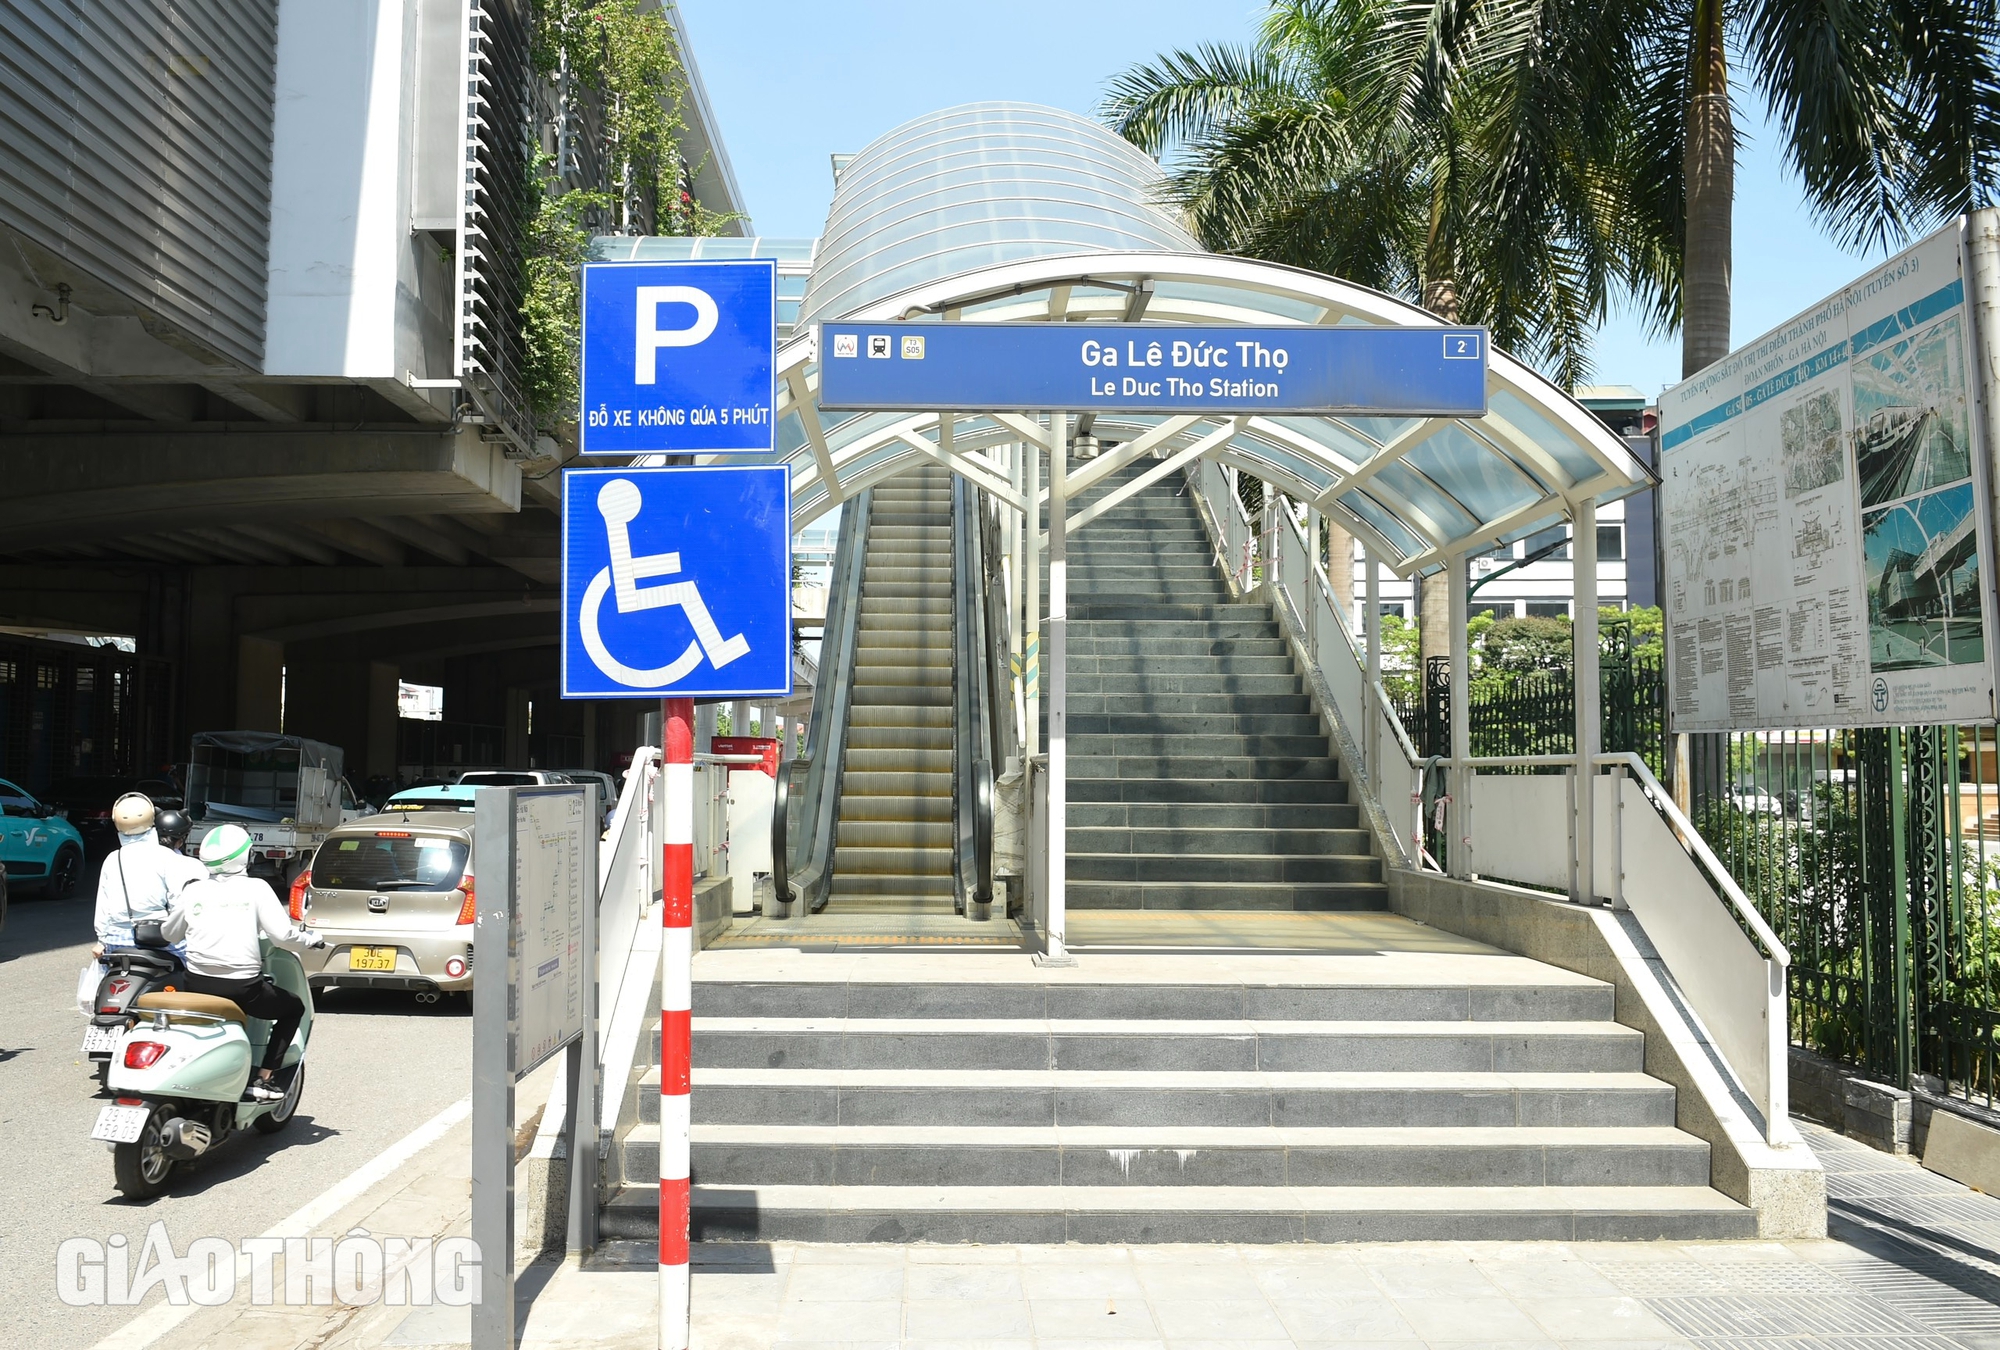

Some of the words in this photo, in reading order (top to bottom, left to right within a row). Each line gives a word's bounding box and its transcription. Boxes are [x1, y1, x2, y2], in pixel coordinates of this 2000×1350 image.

[634, 285, 719, 385] P
[1680, 381, 1699, 402] TUYẾN
[1788, 319, 1815, 341] THÀNH
[1815, 304, 1832, 327] PHỐ
[1846, 291, 1862, 309] NỘI
[1863, 270, 1895, 300] (TUYẾN
[1896, 256, 1909, 281] SỐ
[1910, 256, 1920, 273] 3)
[906, 346, 920, 354] S05
[1457, 340, 1466, 353] 2
[1788, 347, 1800, 361] GA
[1800, 337, 1812, 354] HÀ
[1812, 330, 1828, 348] NỘI
[1081, 340, 1118, 367] Ga
[1128, 340, 1163, 367] Lê
[1171, 340, 1229, 368] Đức
[1235, 341, 1289, 374] Thọ
[1814, 356, 1828, 373] KM
[1091, 377, 1116, 396] Le
[1122, 377, 1161, 396] Duc
[1166, 377, 1203, 397] Tho
[1209, 378, 1279, 397] Station
[588, 403, 608, 427] ĐỖ
[613, 410, 632, 426] XE
[638, 406, 685, 426] KHÔNG
[690, 405, 717, 425] QÚA
[720, 408, 728, 425] 5
[733, 403, 769, 425] PHÚT
[248, 832, 264, 842] .78
[356, 958, 390, 969] 197.37
